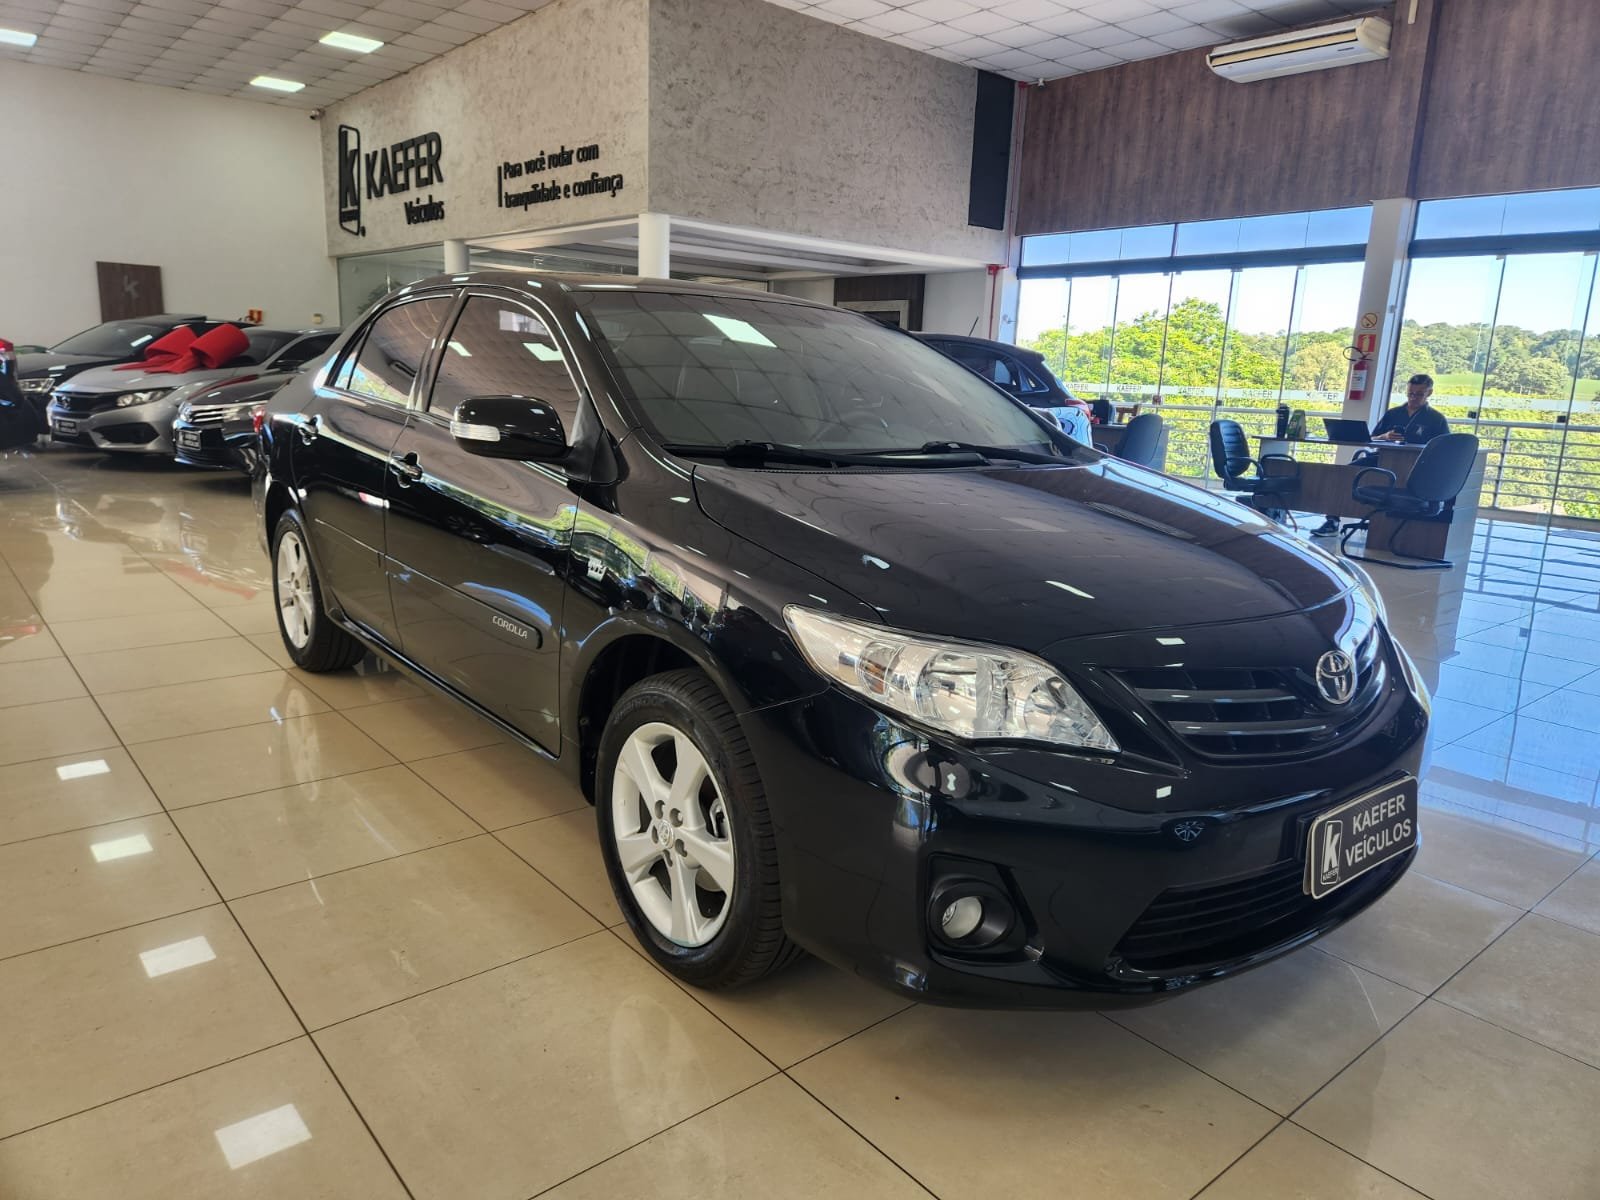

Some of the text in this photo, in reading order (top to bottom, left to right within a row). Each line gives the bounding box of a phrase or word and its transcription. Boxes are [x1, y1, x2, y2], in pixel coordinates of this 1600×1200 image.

[365, 131, 444, 199] KAEFER
[503, 144, 599, 180] Para você rodar com
[563, 184, 571, 199] e
[573, 172, 624, 198] confiança
[404, 194, 445, 225] Veículos
[1306, 391, 1339, 400] KFER
[492, 615, 528, 639] COROLLA
[1352, 794, 1406, 835] KAEFER
[1345, 818, 1412, 867] VEÍCULOS
